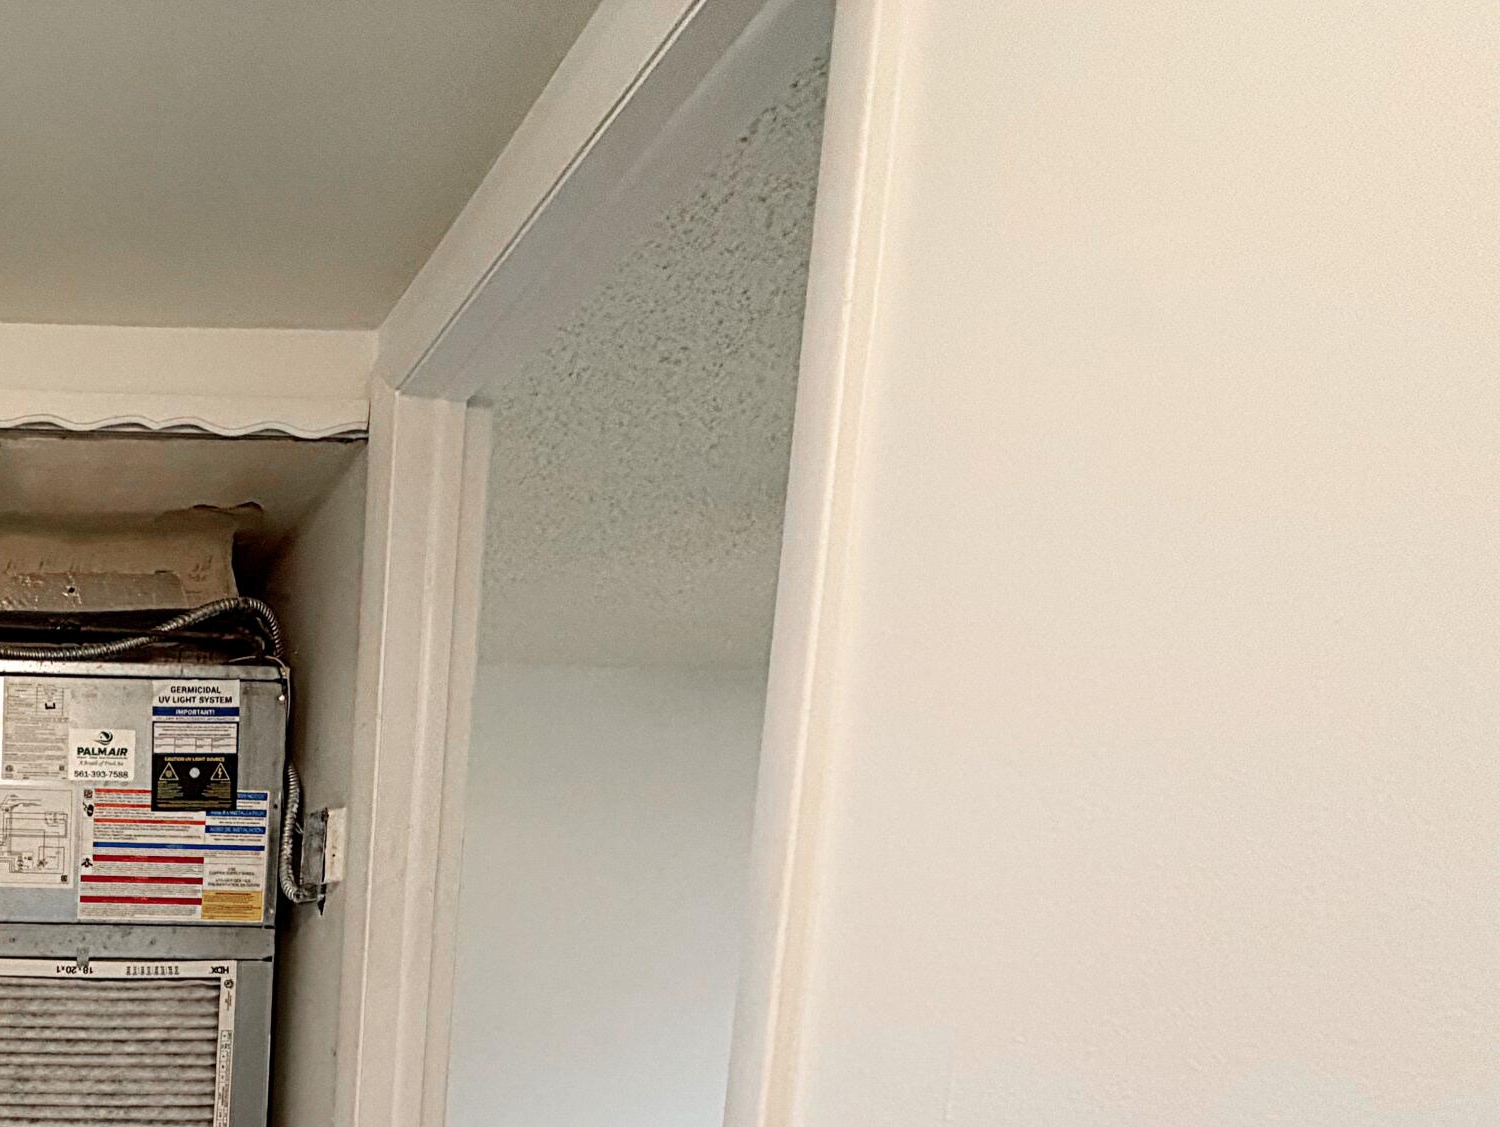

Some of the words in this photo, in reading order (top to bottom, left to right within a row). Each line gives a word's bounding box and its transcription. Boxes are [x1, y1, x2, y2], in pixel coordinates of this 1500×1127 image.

[170, 685, 221, 694] GERMICIDAL
[158, 696, 171, 704] UV
[172, 696, 196, 704] LIGHT
[198, 696, 233, 704] SYSTEM
[175, 708, 216, 716] IMPORTANT!
[74, 770, 129, 779] 561-393-7588
[211, 966, 229, 974] HDX
